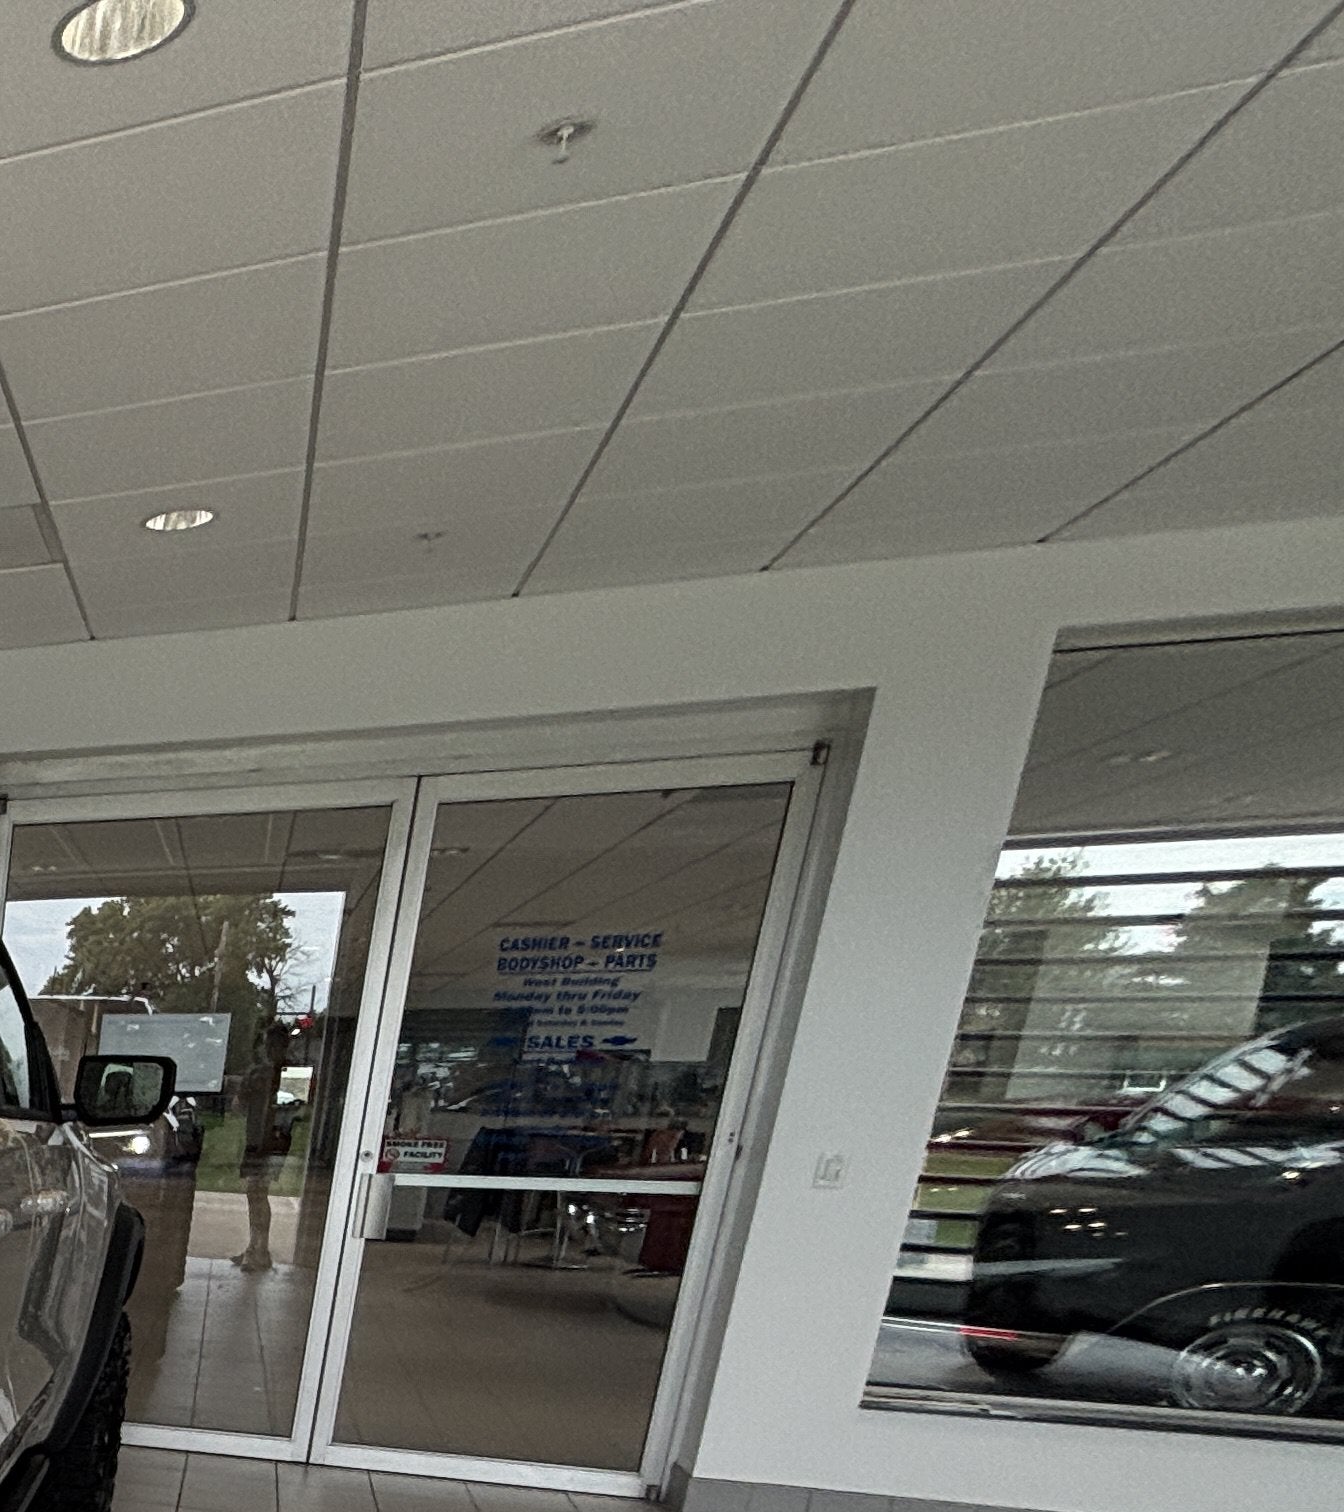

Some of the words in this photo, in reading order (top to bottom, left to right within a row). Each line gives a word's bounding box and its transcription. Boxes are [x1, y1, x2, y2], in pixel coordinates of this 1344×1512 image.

[499, 936, 570, 952] CASHIER
[591, 932, 664, 950] SERVICE
[496, 954, 586, 971] BODYSHOP
[604, 953, 658, 969] PARTS
[493, 991, 551, 1003] Monday
[556, 990, 589, 1001] thru
[592, 989, 642, 1003] Friday
[527, 1035, 595, 1049] SALES
[386, 1140, 419, 1148] SMOKE
[403, 1150, 443, 1159] FACILITY
